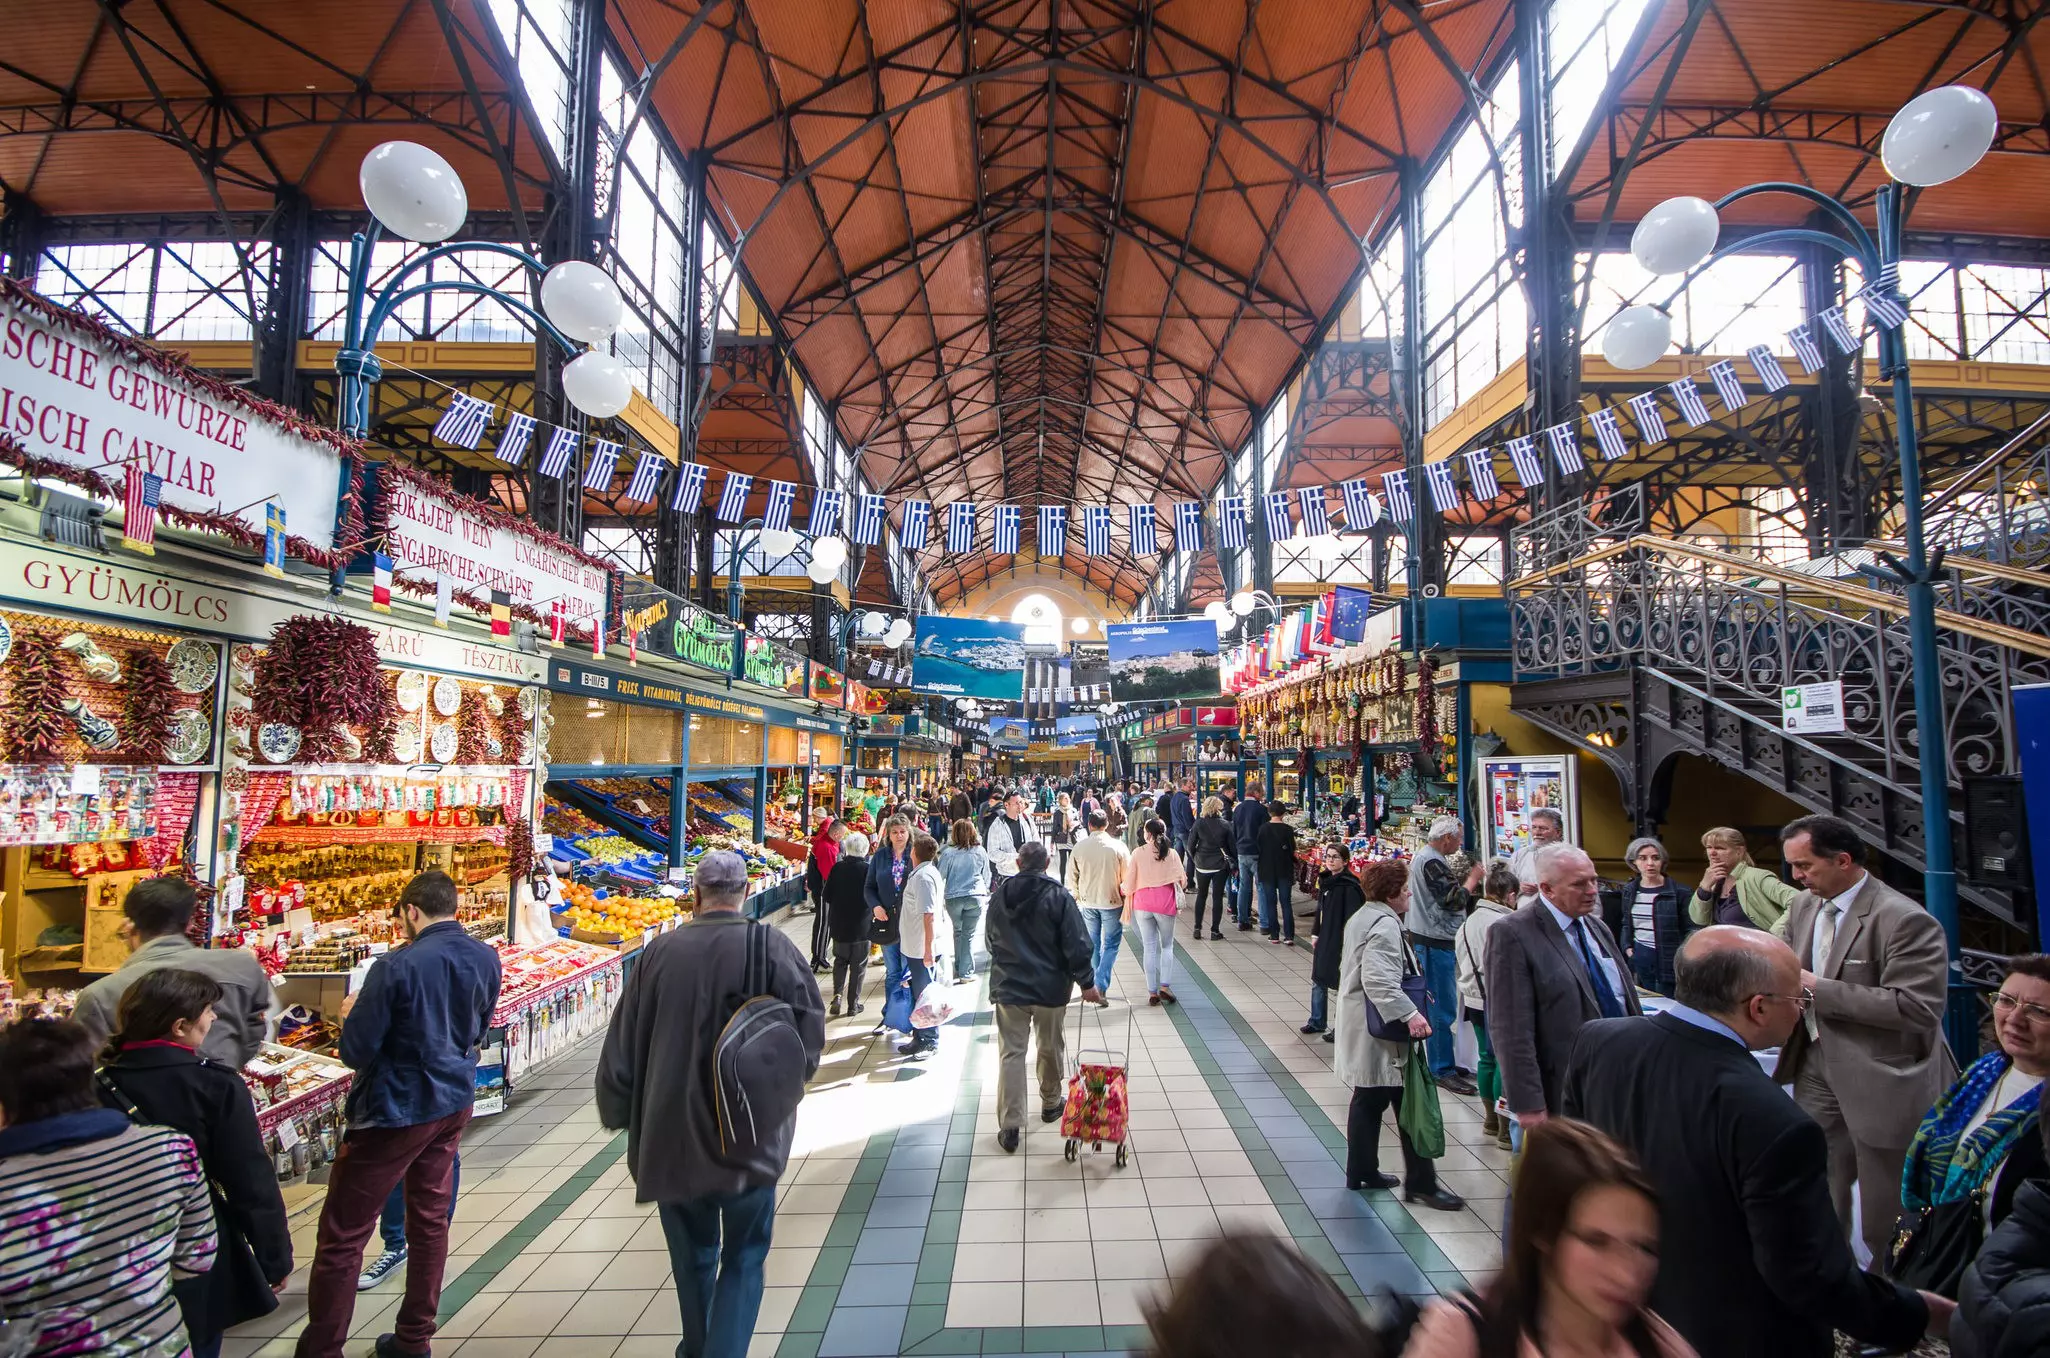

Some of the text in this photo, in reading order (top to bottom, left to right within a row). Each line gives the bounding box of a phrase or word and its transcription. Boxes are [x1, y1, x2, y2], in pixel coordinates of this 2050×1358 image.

[0, 311, 248, 453] SCHE GEWÜRZE
[0, 387, 217, 498] ISCH CAVIAR
[391, 531, 534, 601] NGARISCHE-SCHNÄPSE
[462, 517, 493, 550] WEIN
[514, 540, 579, 585] UNGARISCHER
[583, 569, 606, 595] HONIG
[24, 560, 229, 622] GYÜMÖLCS
[462, 645, 524, 675] TÉSZTÁK
[673, 619, 733, 671] GYÜMÖLCS
[617, 679, 640, 697] FRISS,
